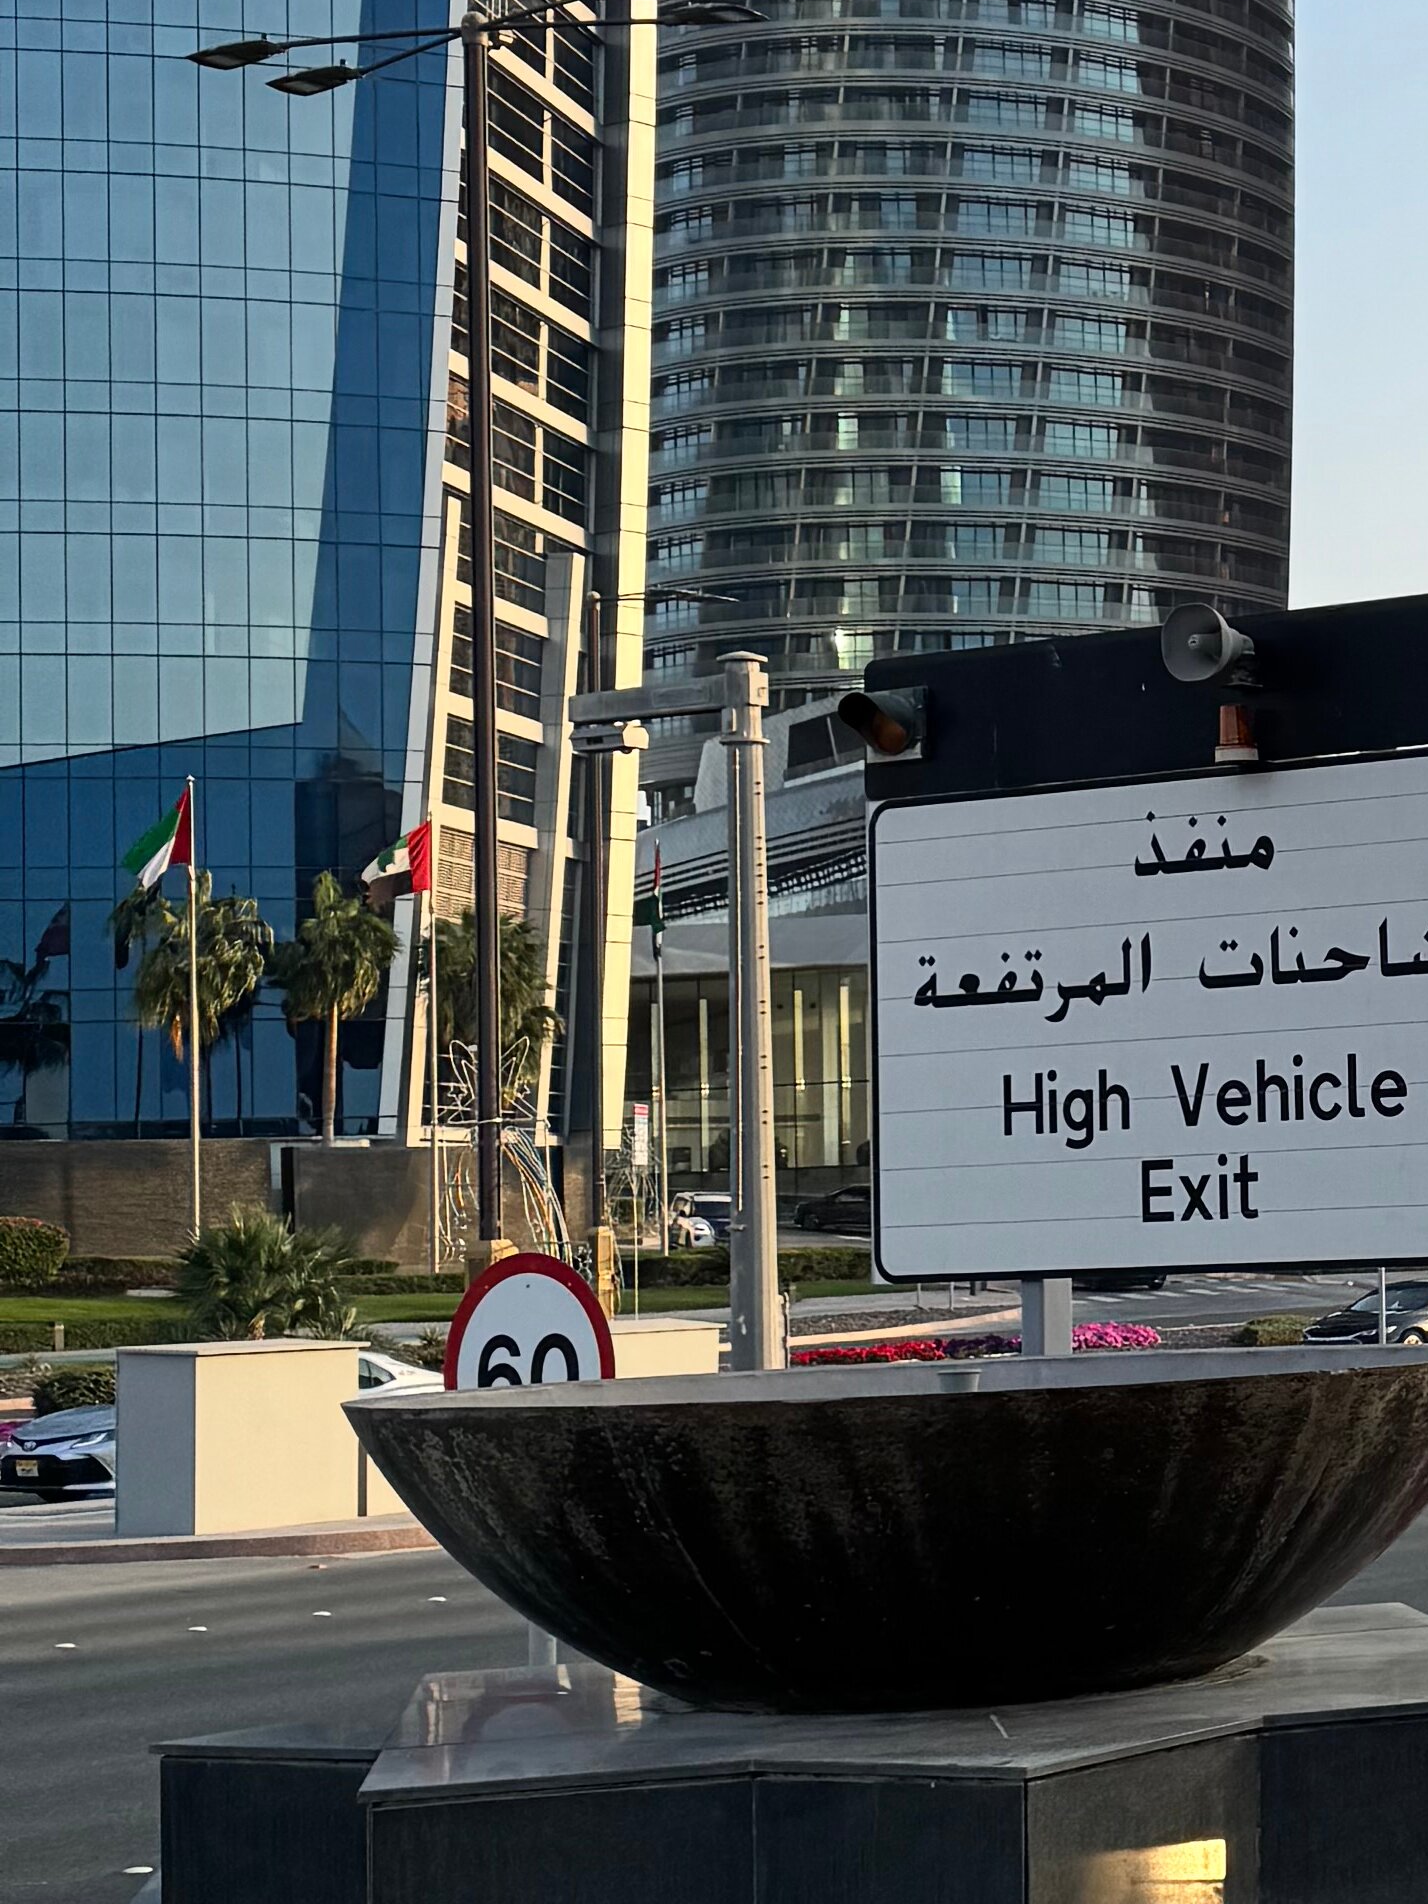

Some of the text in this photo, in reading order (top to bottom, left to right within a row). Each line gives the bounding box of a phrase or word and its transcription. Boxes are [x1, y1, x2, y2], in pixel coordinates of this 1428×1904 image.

[1134, 811, 1275, 877] منفذ
[913, 932, 1152, 1023] المرتفعة
[1002, 1053, 1408, 1150] High Vehicle
[1141, 1153, 1259, 1223] Exit
[477, 1332, 580, 1389] 60
